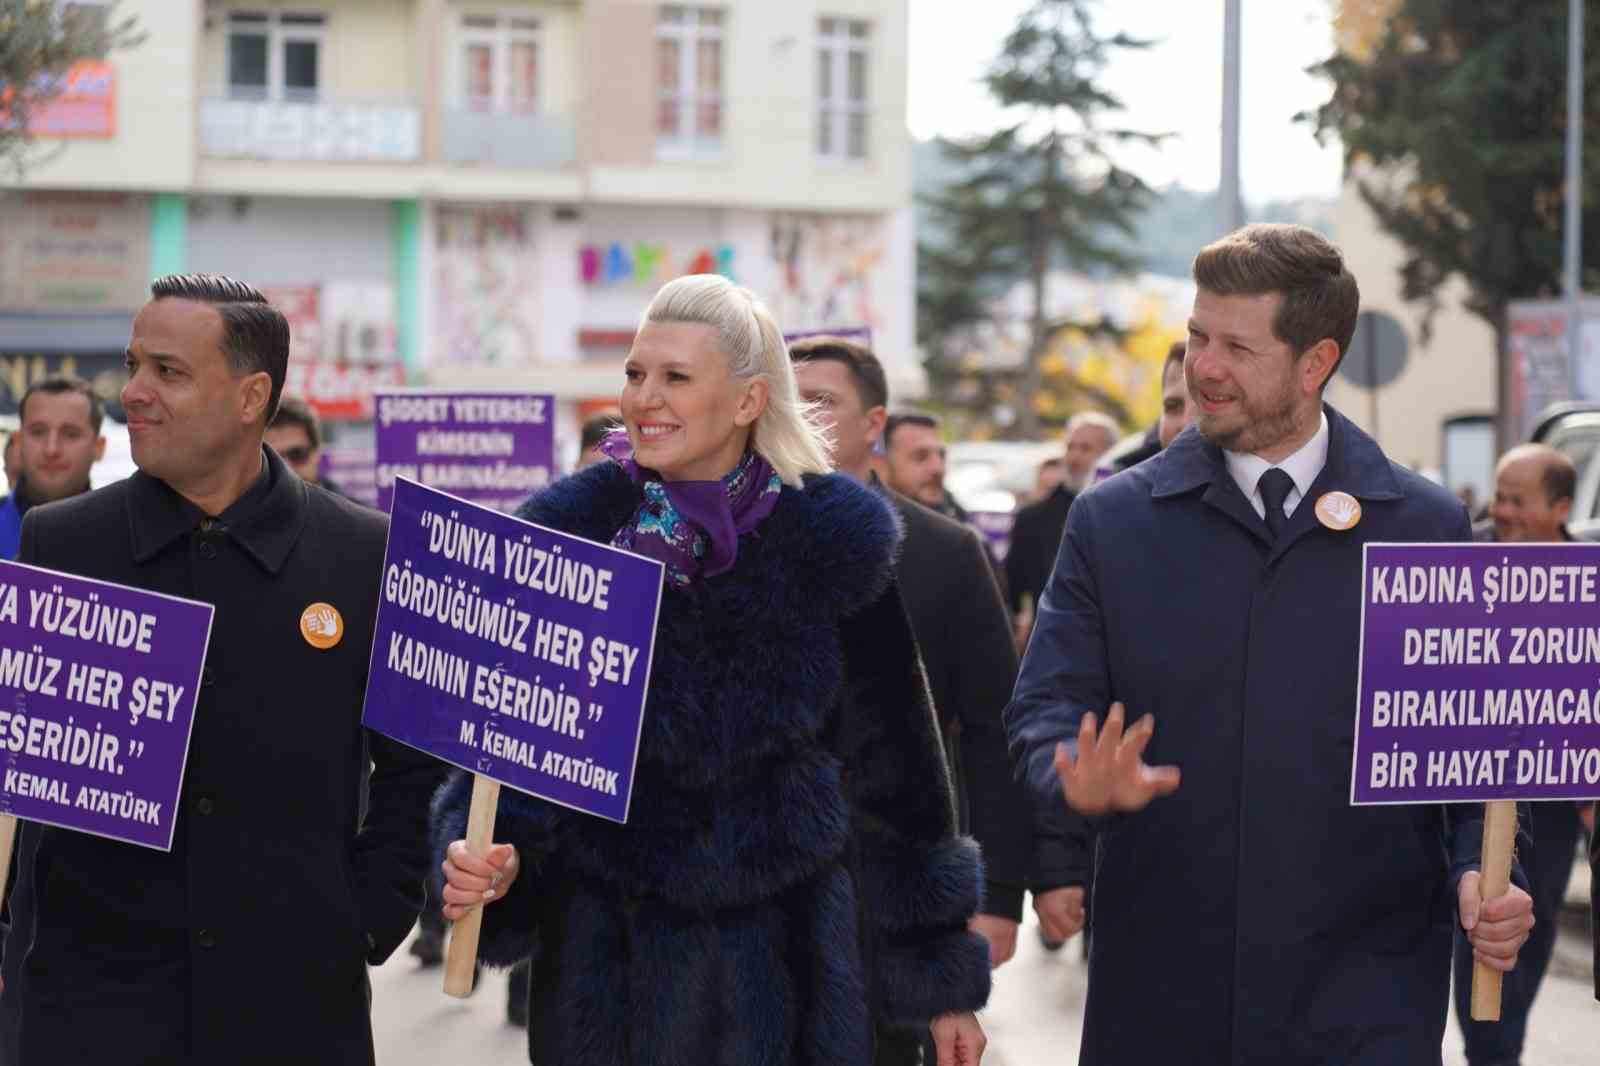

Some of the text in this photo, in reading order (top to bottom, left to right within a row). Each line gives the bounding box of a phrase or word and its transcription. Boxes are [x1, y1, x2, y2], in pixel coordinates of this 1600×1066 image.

[504, 535, 613, 610] YÜZÜNDE
[1371, 556, 1598, 614] KADINA ŞİDDETE
[28, 585, 157, 653] YÜZÜNDE
[385, 559, 639, 687] GÖRDÜĞÜMÜZ HER ŞEY
[1403, 627, 1600, 665] DEMEK ZORUN
[66, 662, 124, 710] HER
[128, 677, 185, 726] ŞEY
[387, 631, 469, 699] KADININ
[459, 720, 619, 796] M. KEMAL ATATÜRK
[1370, 739, 1600, 789] BİR HAYAT DİLİYO
[4, 769, 161, 826] KEMAL ATATÜRK
